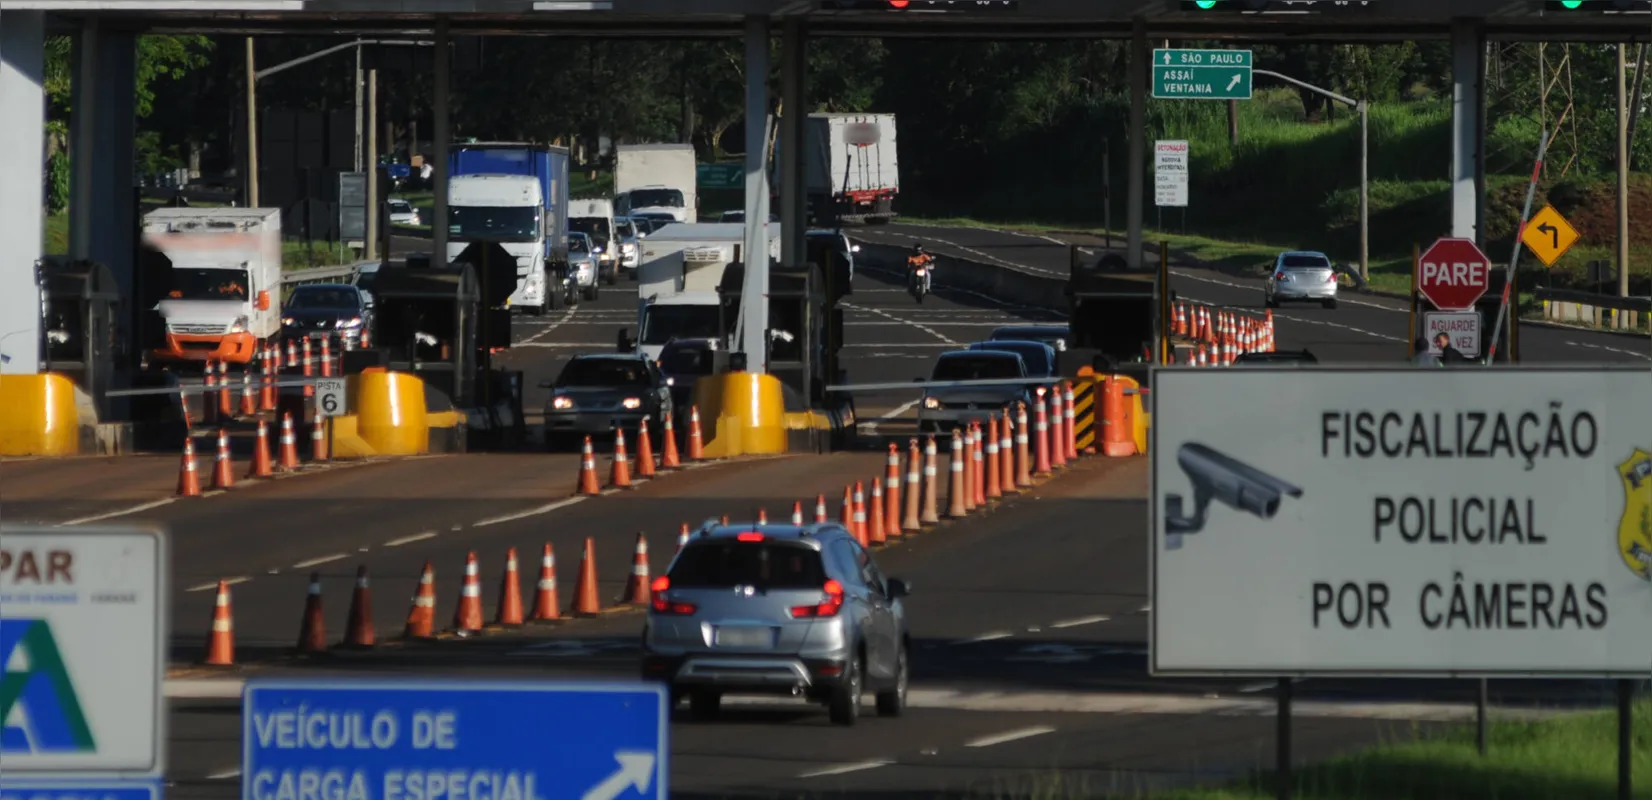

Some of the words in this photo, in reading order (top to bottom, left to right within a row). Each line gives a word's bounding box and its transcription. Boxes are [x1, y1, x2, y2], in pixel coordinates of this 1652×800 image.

[1181, 52, 1202, 64] SÃO
[1210, 54, 1243, 64] PAULO
[1163, 69, 1194, 81] ASSAÍ
[1163, 83, 1212, 94] VENTANIA
[1423, 262, 1484, 286] PARE
[1430, 319, 1476, 332] AGUARDE
[1455, 337, 1474, 349] VEZ
[317, 381, 342, 390] PISTA
[322, 393, 338, 413] 6
[1321, 401, 1598, 471] FISCALIZAÇÃO
[1374, 496, 1547, 544] POLICIAL
[1312, 581, 1391, 630] POR
[1419, 570, 1608, 630] CÂMERAS
[252, 703, 397, 750] VEÍCULO
[412, 711, 456, 750] DE
[251, 770, 369, 800] CARGA
[383, 770, 543, 800] ESPECIAL
